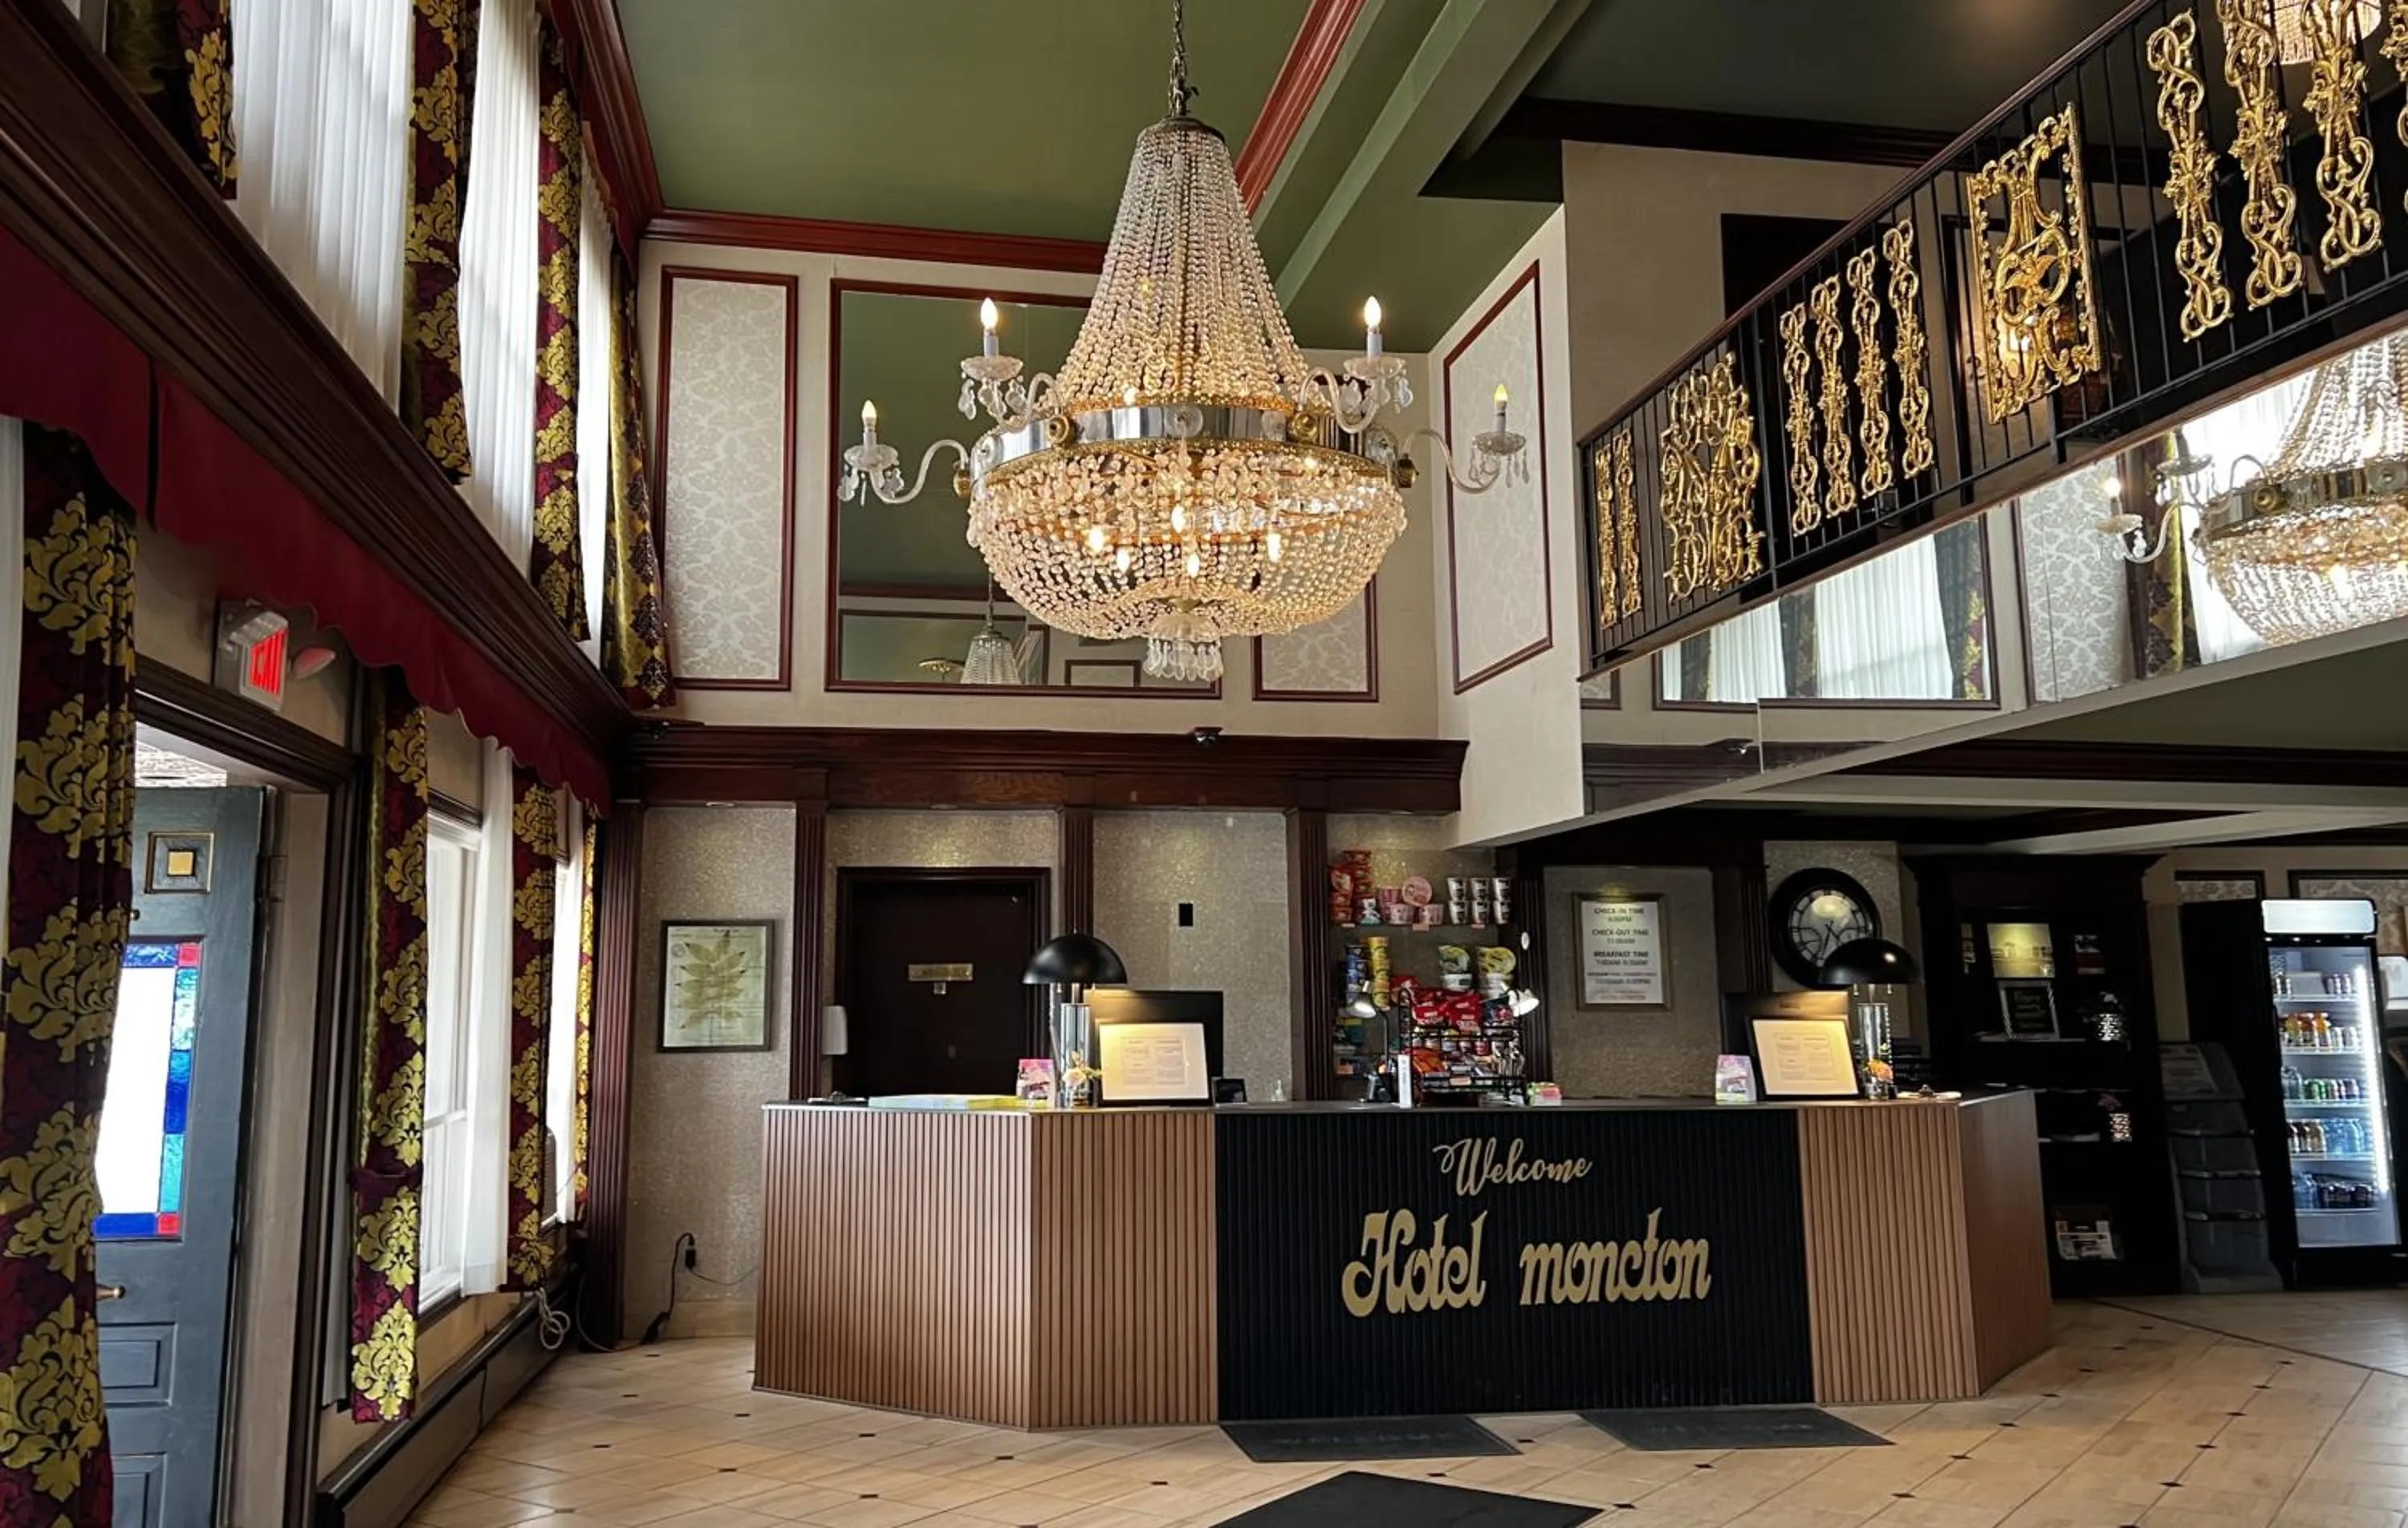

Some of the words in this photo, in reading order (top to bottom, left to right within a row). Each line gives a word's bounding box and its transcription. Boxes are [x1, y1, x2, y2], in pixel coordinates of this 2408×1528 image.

[1433, 1137, 1592, 1196] Welcome
[1342, 1209, 1487, 1316] Hotel
[1519, 1208, 1710, 1305] moncton
